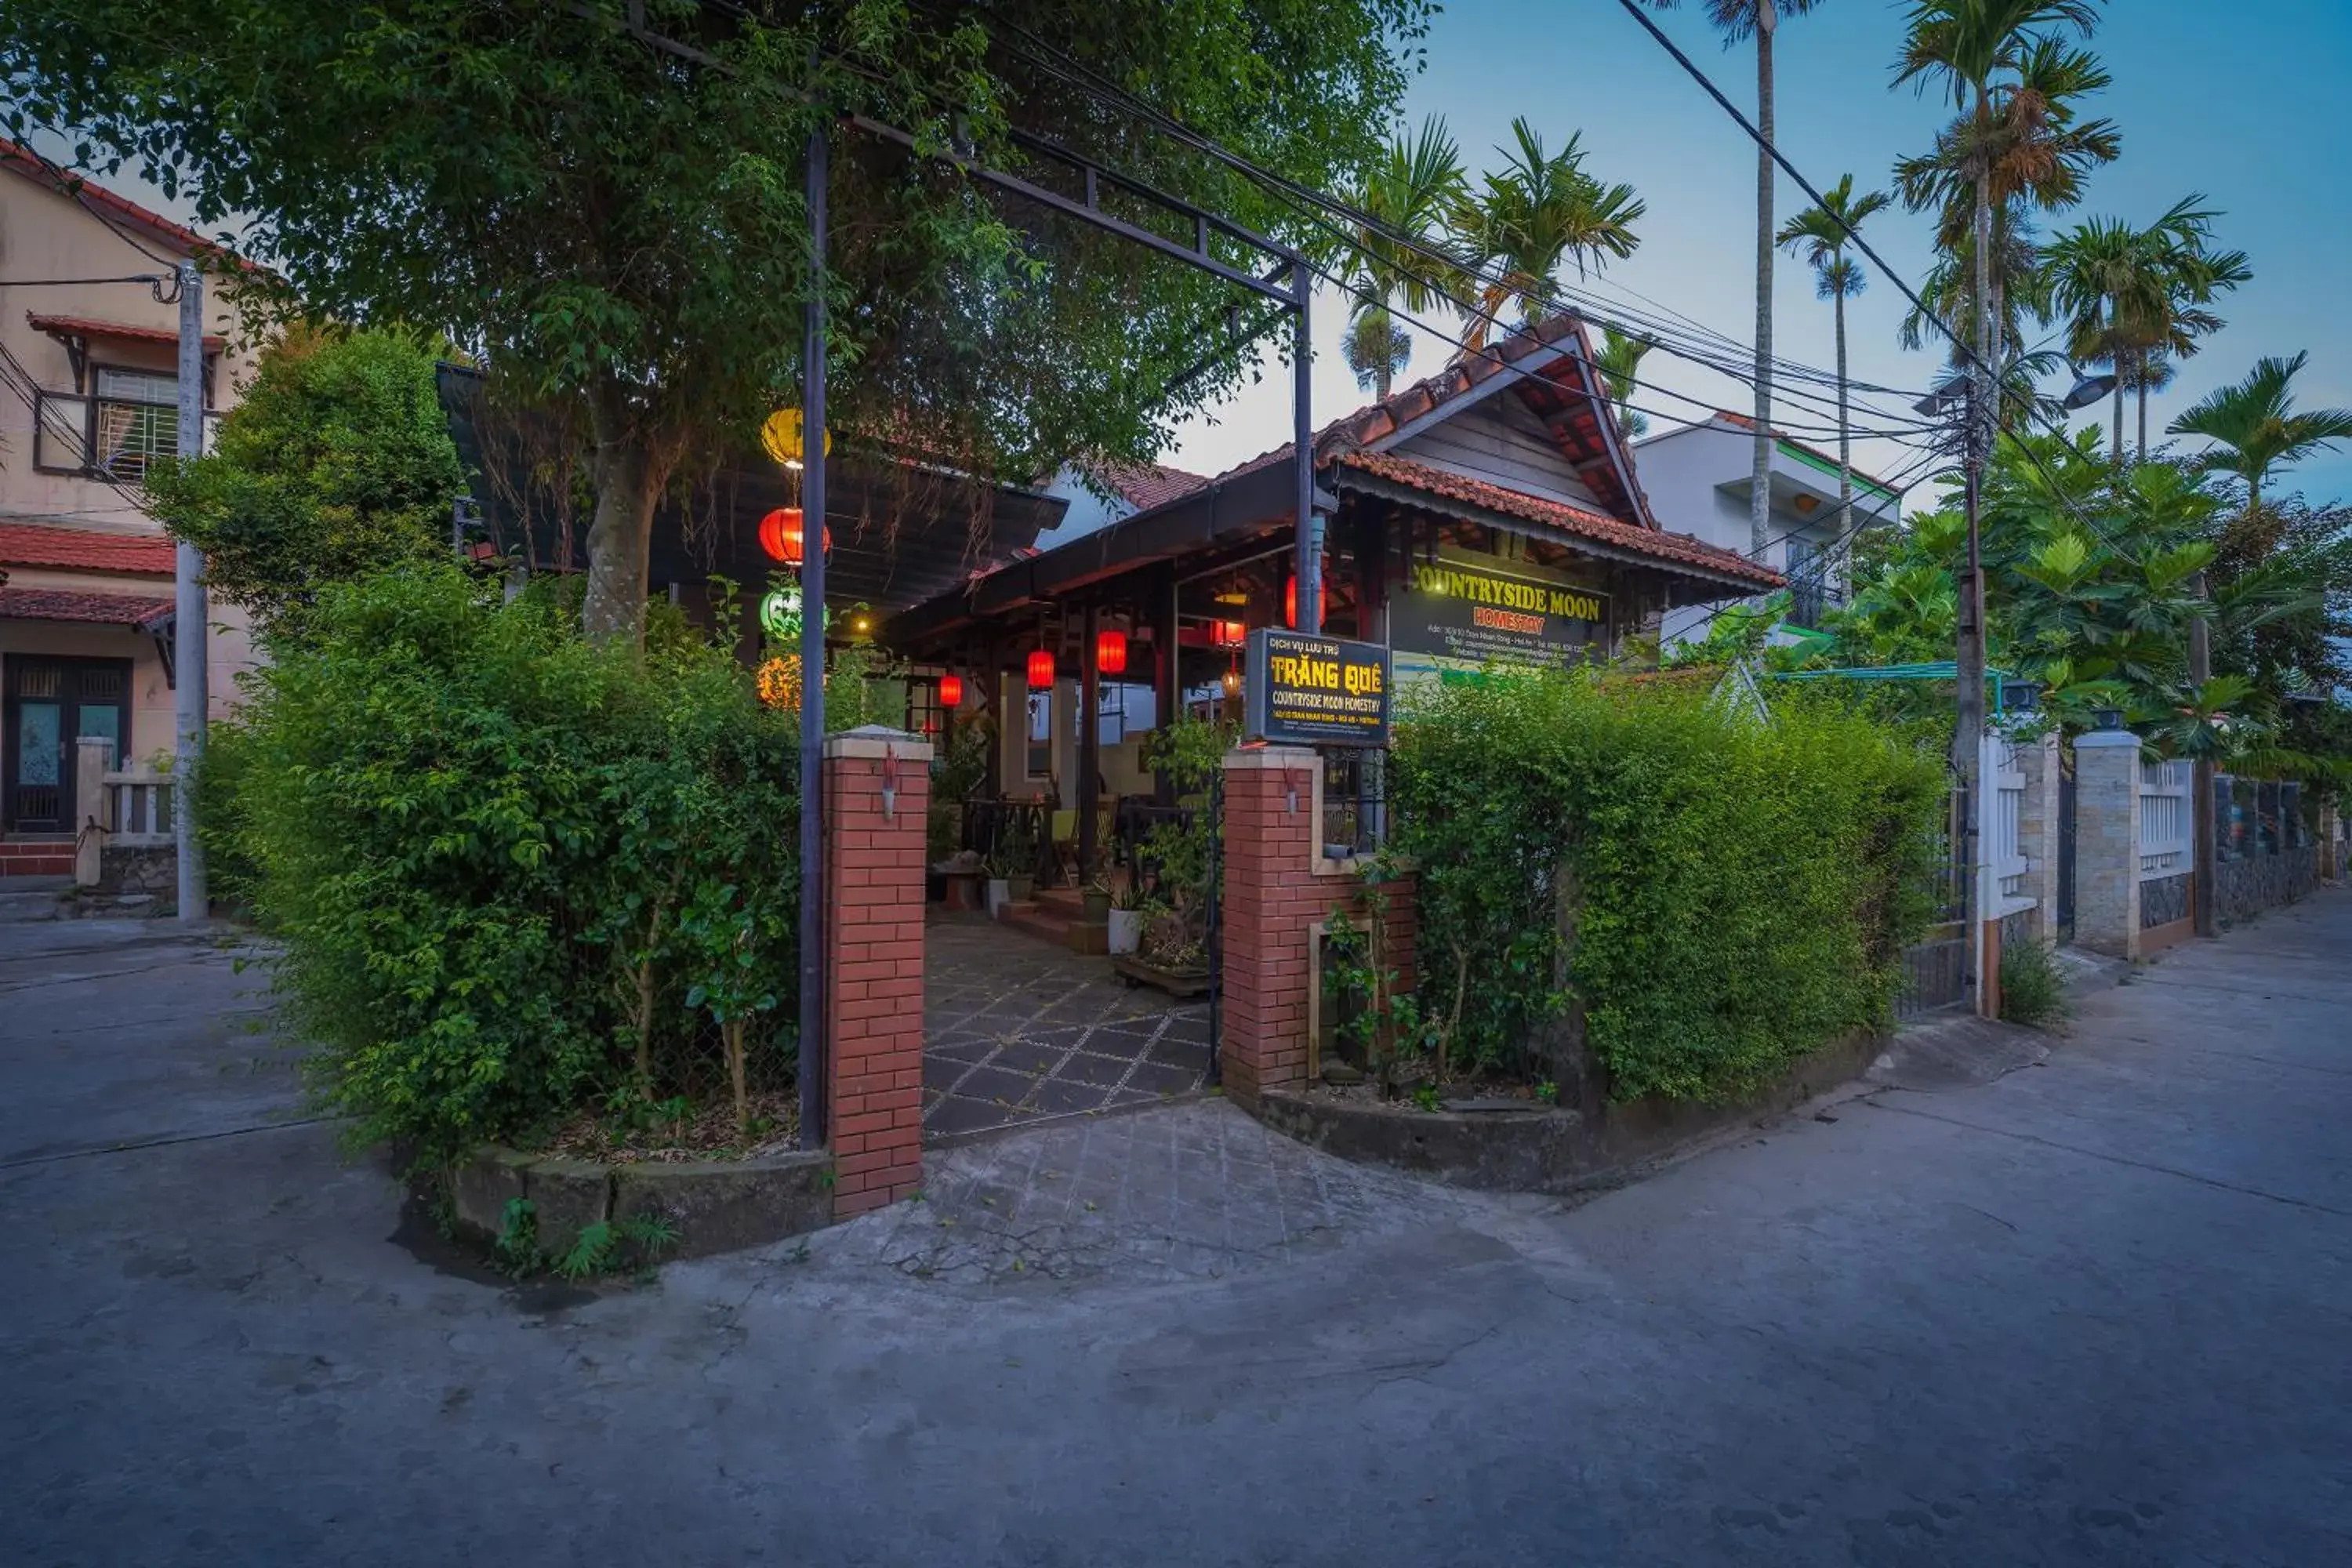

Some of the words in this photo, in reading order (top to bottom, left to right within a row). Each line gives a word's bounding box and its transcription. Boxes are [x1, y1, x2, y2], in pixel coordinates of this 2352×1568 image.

[1550, 590, 1599, 621] MOON
[1473, 606, 1545, 635] HOMESTAY
[1292, 641, 1304, 653] VỤ
[1271, 654, 1339, 688] TRĂNG
[1344, 662, 1382, 695] QUÊ
[1272, 690, 1322, 708] COUNTRYSIDE
[1323, 694, 1344, 710] MOON
